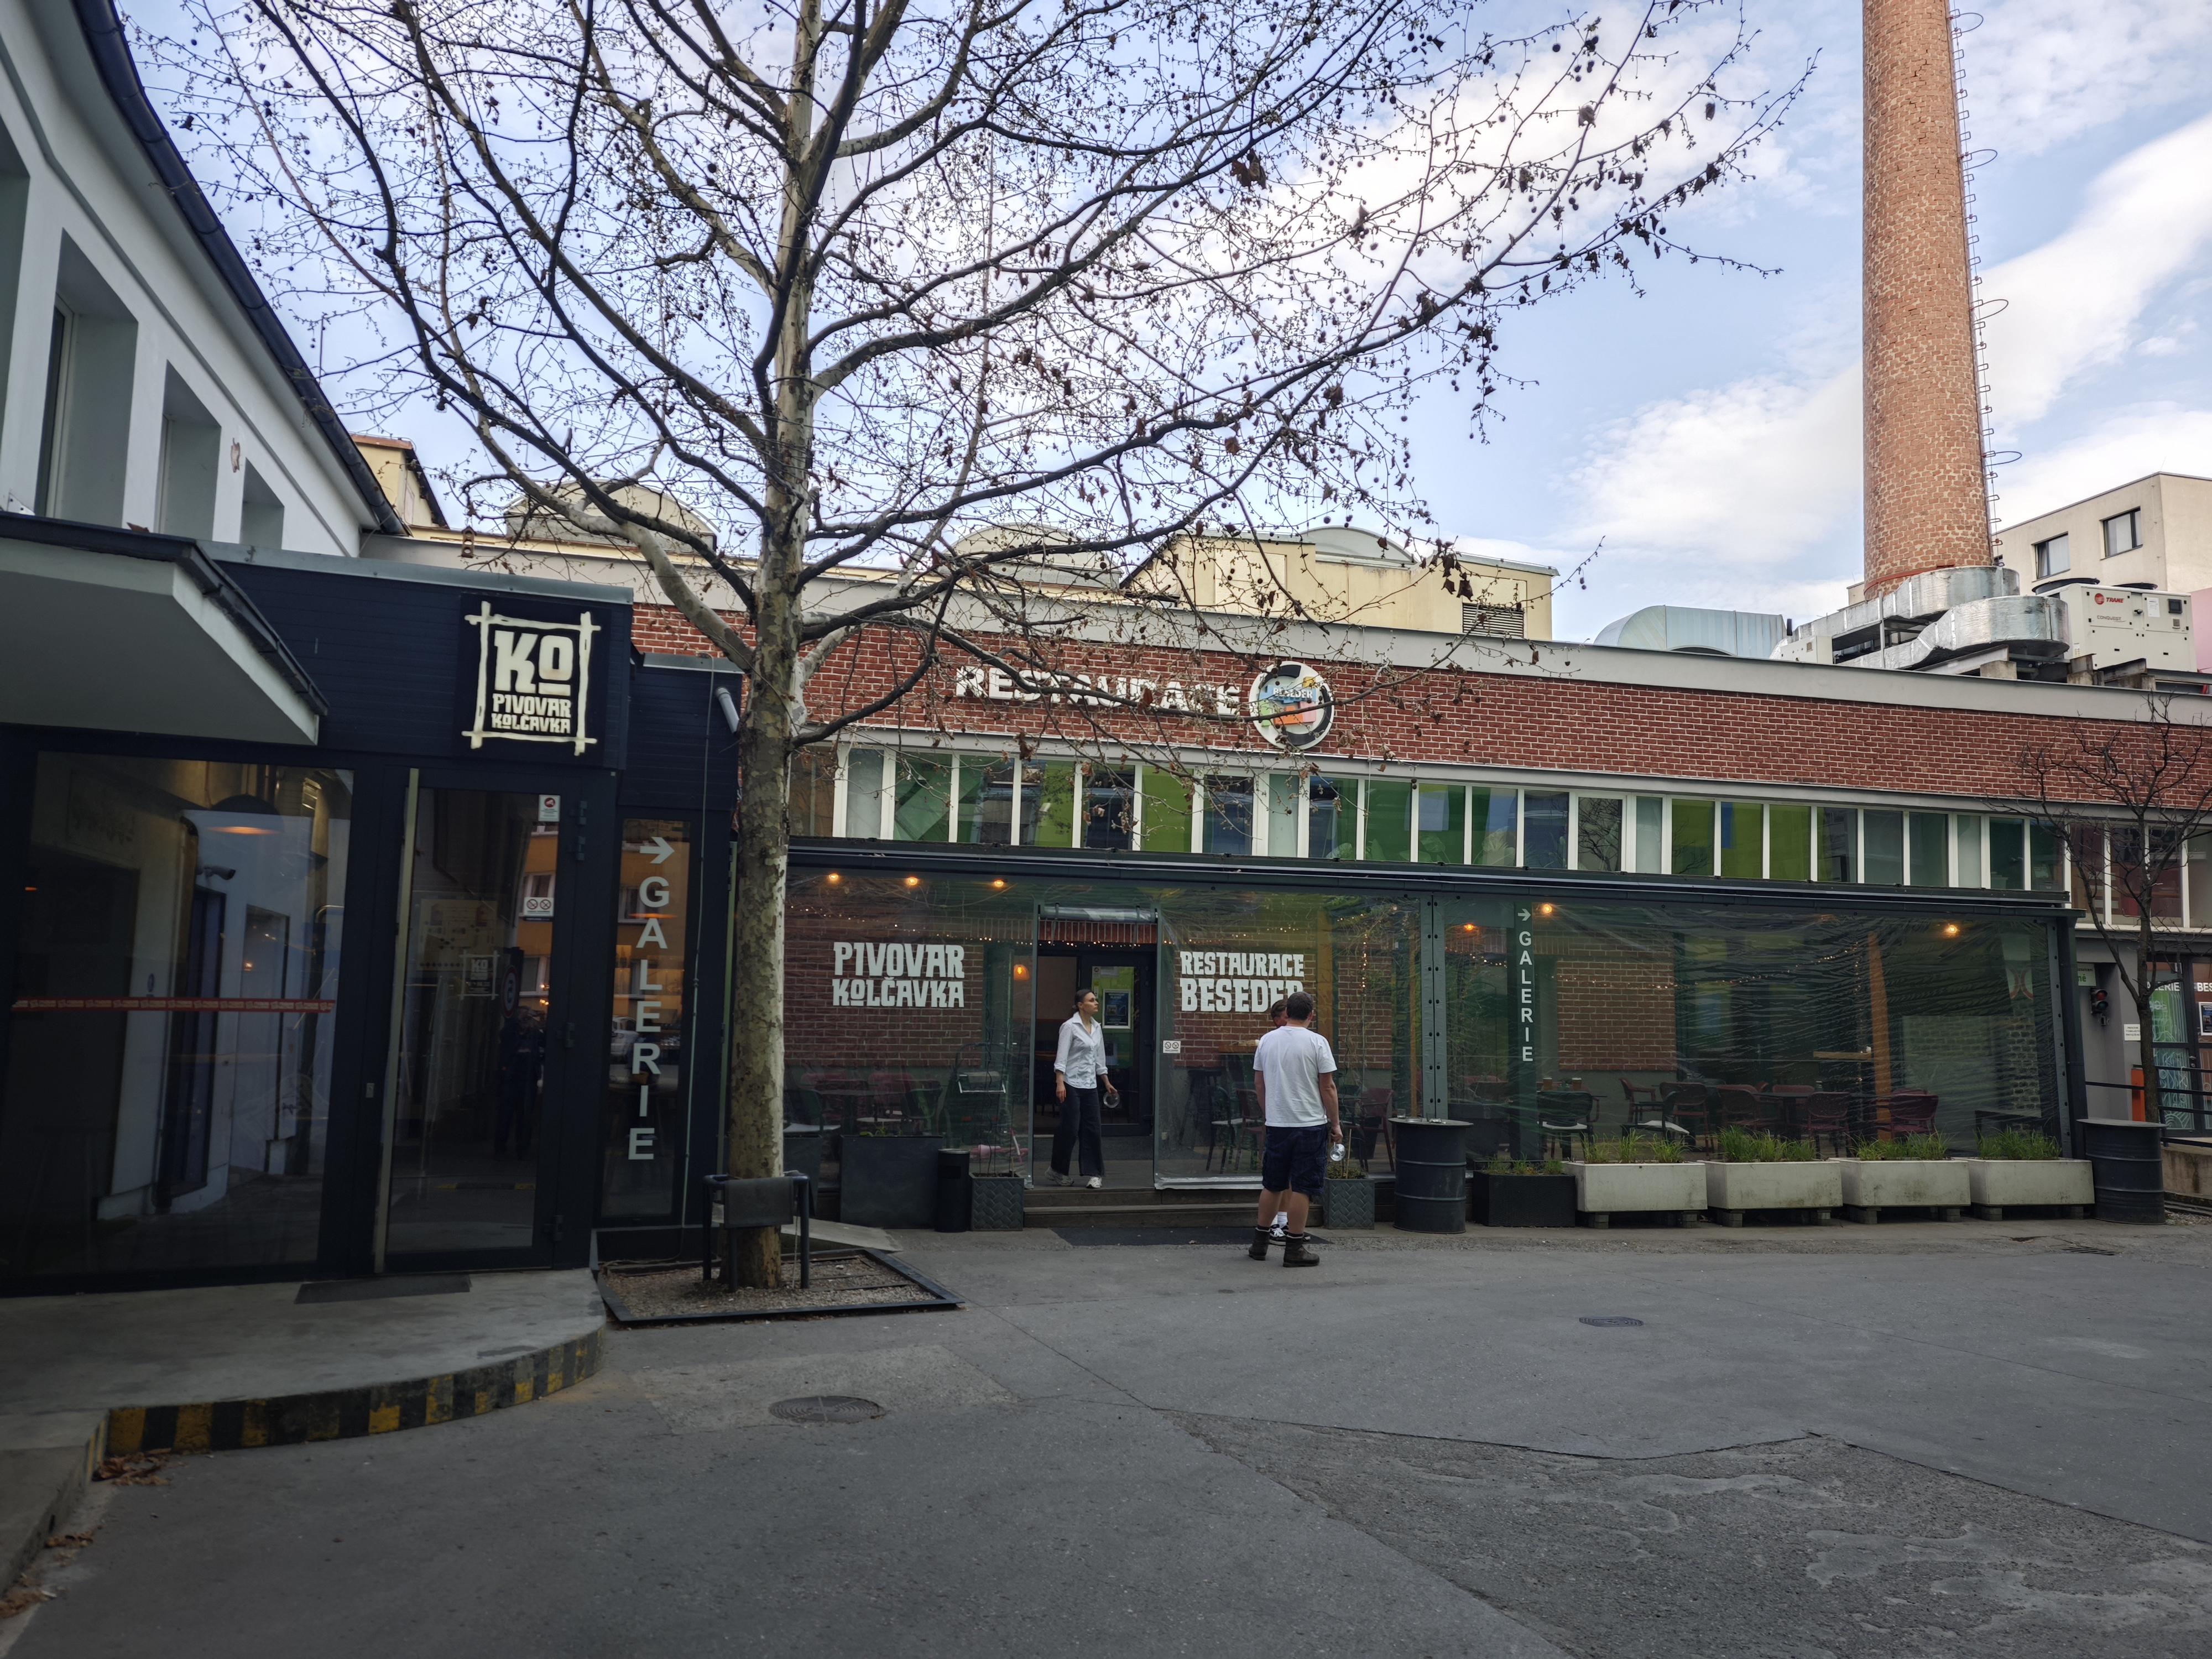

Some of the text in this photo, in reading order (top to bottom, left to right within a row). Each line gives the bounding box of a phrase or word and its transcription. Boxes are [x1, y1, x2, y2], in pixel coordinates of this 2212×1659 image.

[494, 630, 573, 697] KO
[493, 693, 571, 718] PIVOVAR
[492, 712, 571, 734] KOLČAVKA
[833, 942, 965, 978] PIVOVAR
[1180, 951, 1305, 977] RESTAURACE
[832, 977, 965, 1008] KOLČAVKA
[1518, 931, 1533, 1062] GALERIE
[2147, 982, 2180, 991] AERIE
[628, 875, 670, 1160] GALERIE
